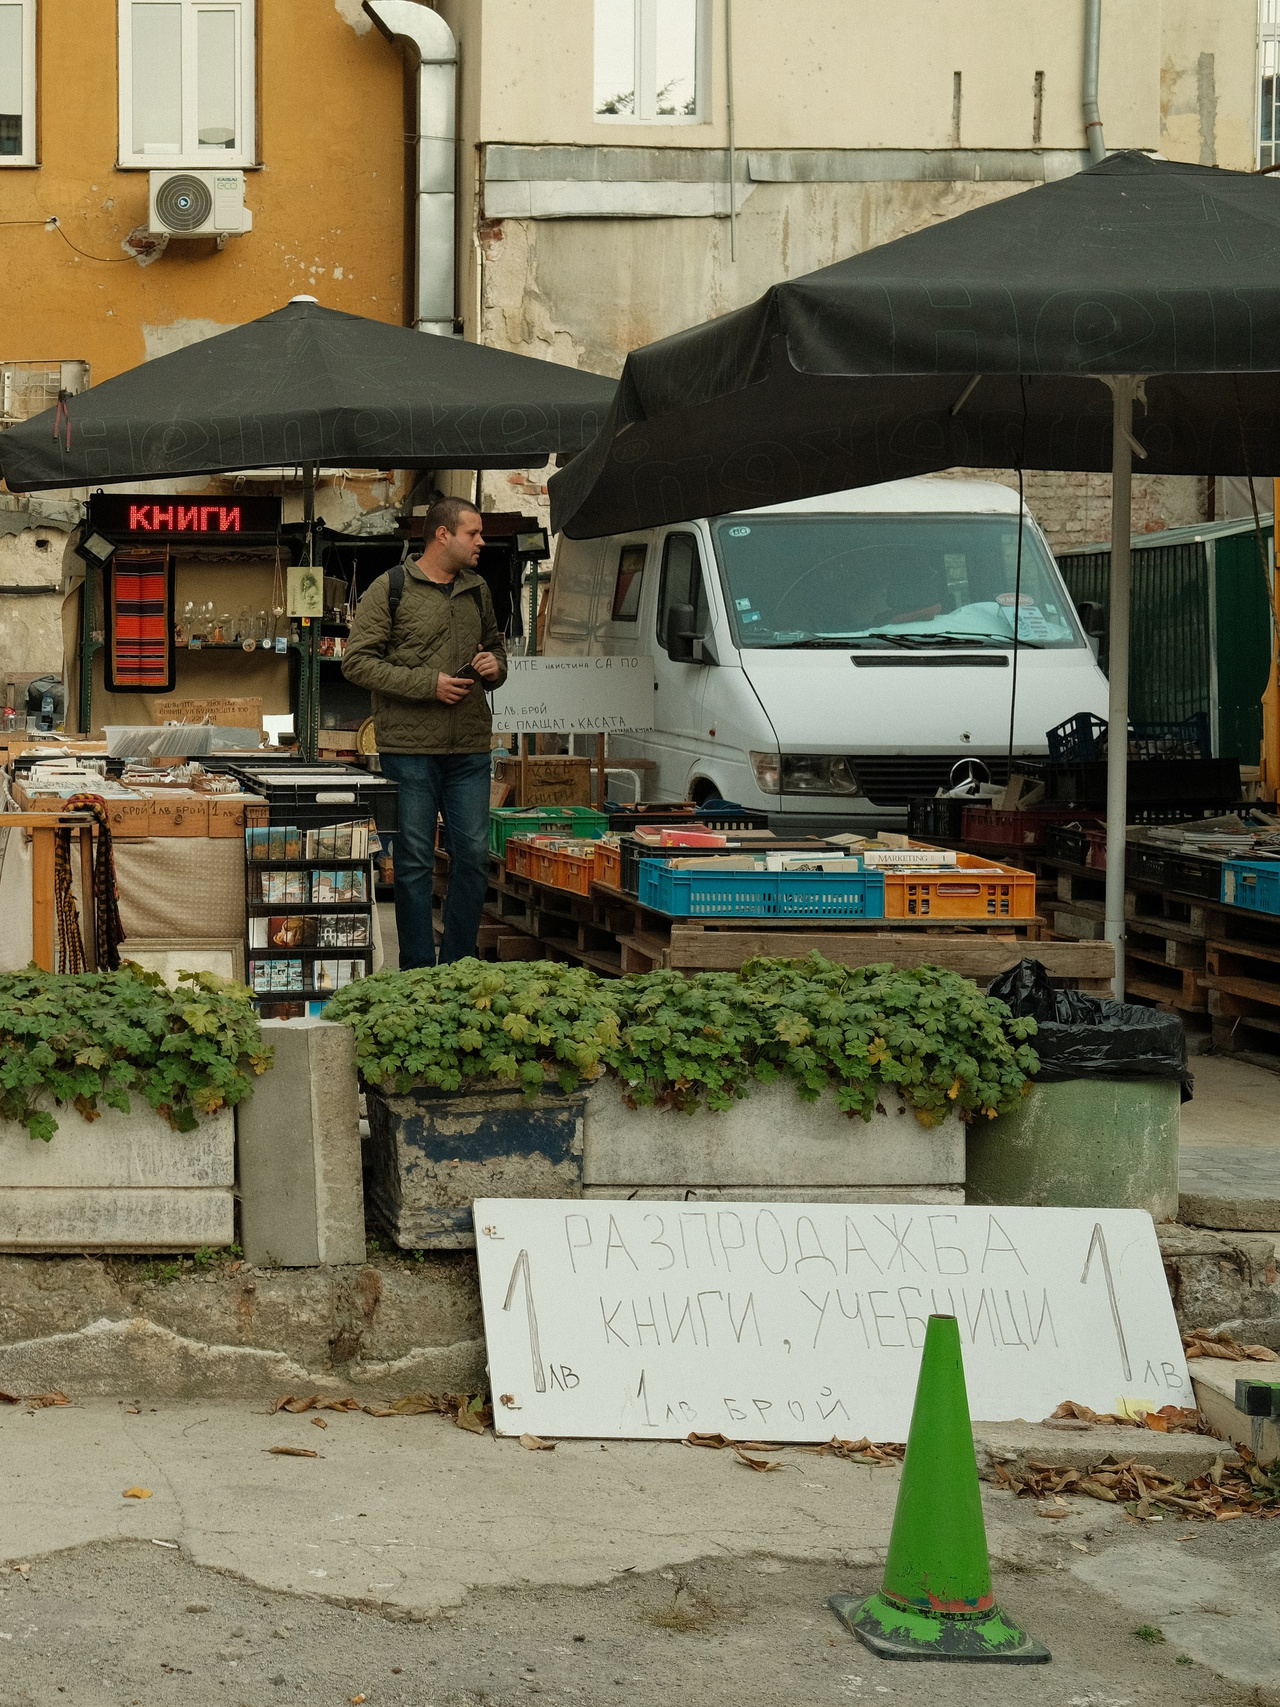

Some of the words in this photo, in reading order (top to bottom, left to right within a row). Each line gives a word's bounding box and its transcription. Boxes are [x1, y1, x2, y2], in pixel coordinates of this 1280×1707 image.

[129, 505, 241, 532] КНИГИ
[507, 659, 538, 672] ГИТЕ
[595, 657, 613, 669] СА
[620, 657, 639, 669] ПО
[521, 702, 548, 716] БРОЙ
[496, 720, 510, 731] СЕ
[516, 718, 566, 731] ПЛАЩАТ
[578, 716, 627, 730] КАСАТА
[531, 765, 570, 778] КАСА
[122, 802, 148, 816] БРОЙ
[149, 800, 157, 815] 1
[176, 802, 206, 816] БРОЙ
[211, 801, 219, 816] 1
[878, 854, 928, 863] MARKETING
[564, 1208, 1029, 1277] РАЗПРОДАЖБА
[1079, 1221, 1134, 1382] 1
[501, 1248, 548, 1393] 1
[636, 1368, 659, 1428] 1
[723, 1385, 850, 1425] БРОЙ
